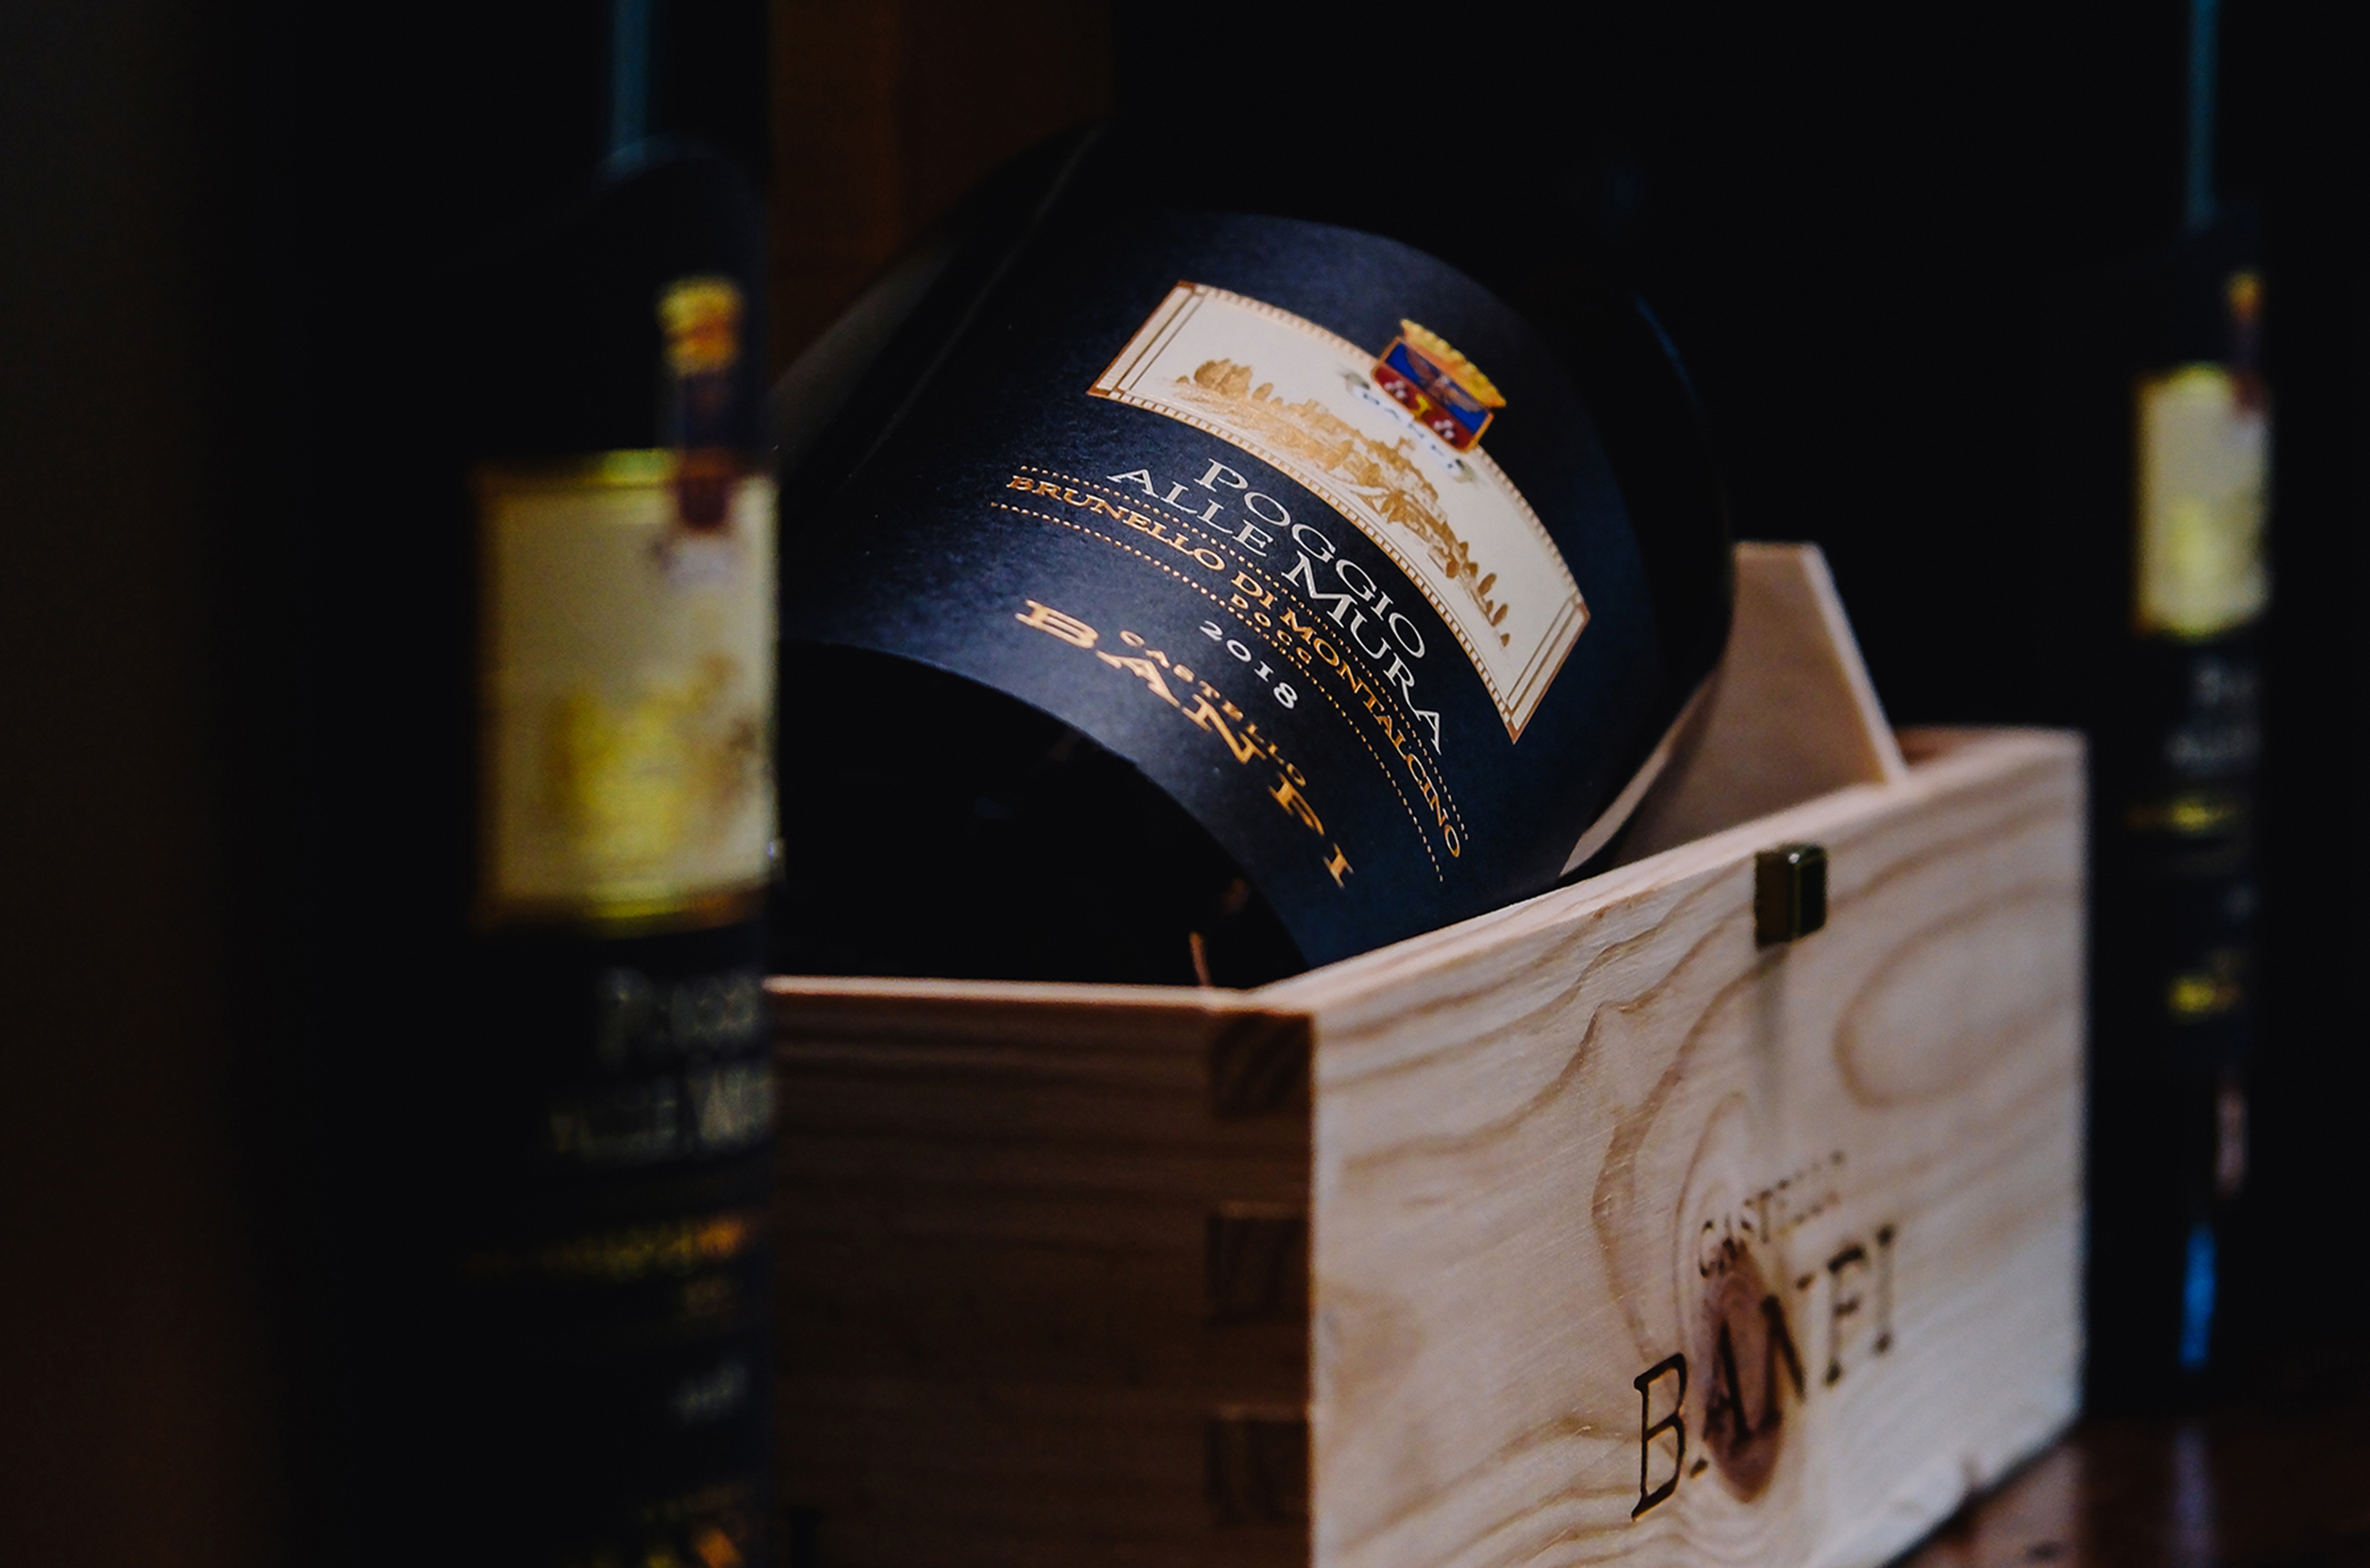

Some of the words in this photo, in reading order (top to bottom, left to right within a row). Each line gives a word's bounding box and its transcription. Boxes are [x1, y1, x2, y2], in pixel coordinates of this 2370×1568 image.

[1005, 474, 1227, 572] BRUNELLO
[1230, 571, 1279, 610] DI
[1279, 611, 1462, 859] MONTALCINO
[1106, 468, 1275, 558] ALLE
[1281, 551, 1444, 756] MURA
[1194, 458, 1427, 660] POGGIO
[1199, 620, 1299, 710] 2018
[1230, 593, 1314, 665] DOCG
[1015, 598, 1355, 890] BANFI
[1118, 629, 1308, 788] CASTELLO
[1632, 1222, 1896, 1522] BANFI
